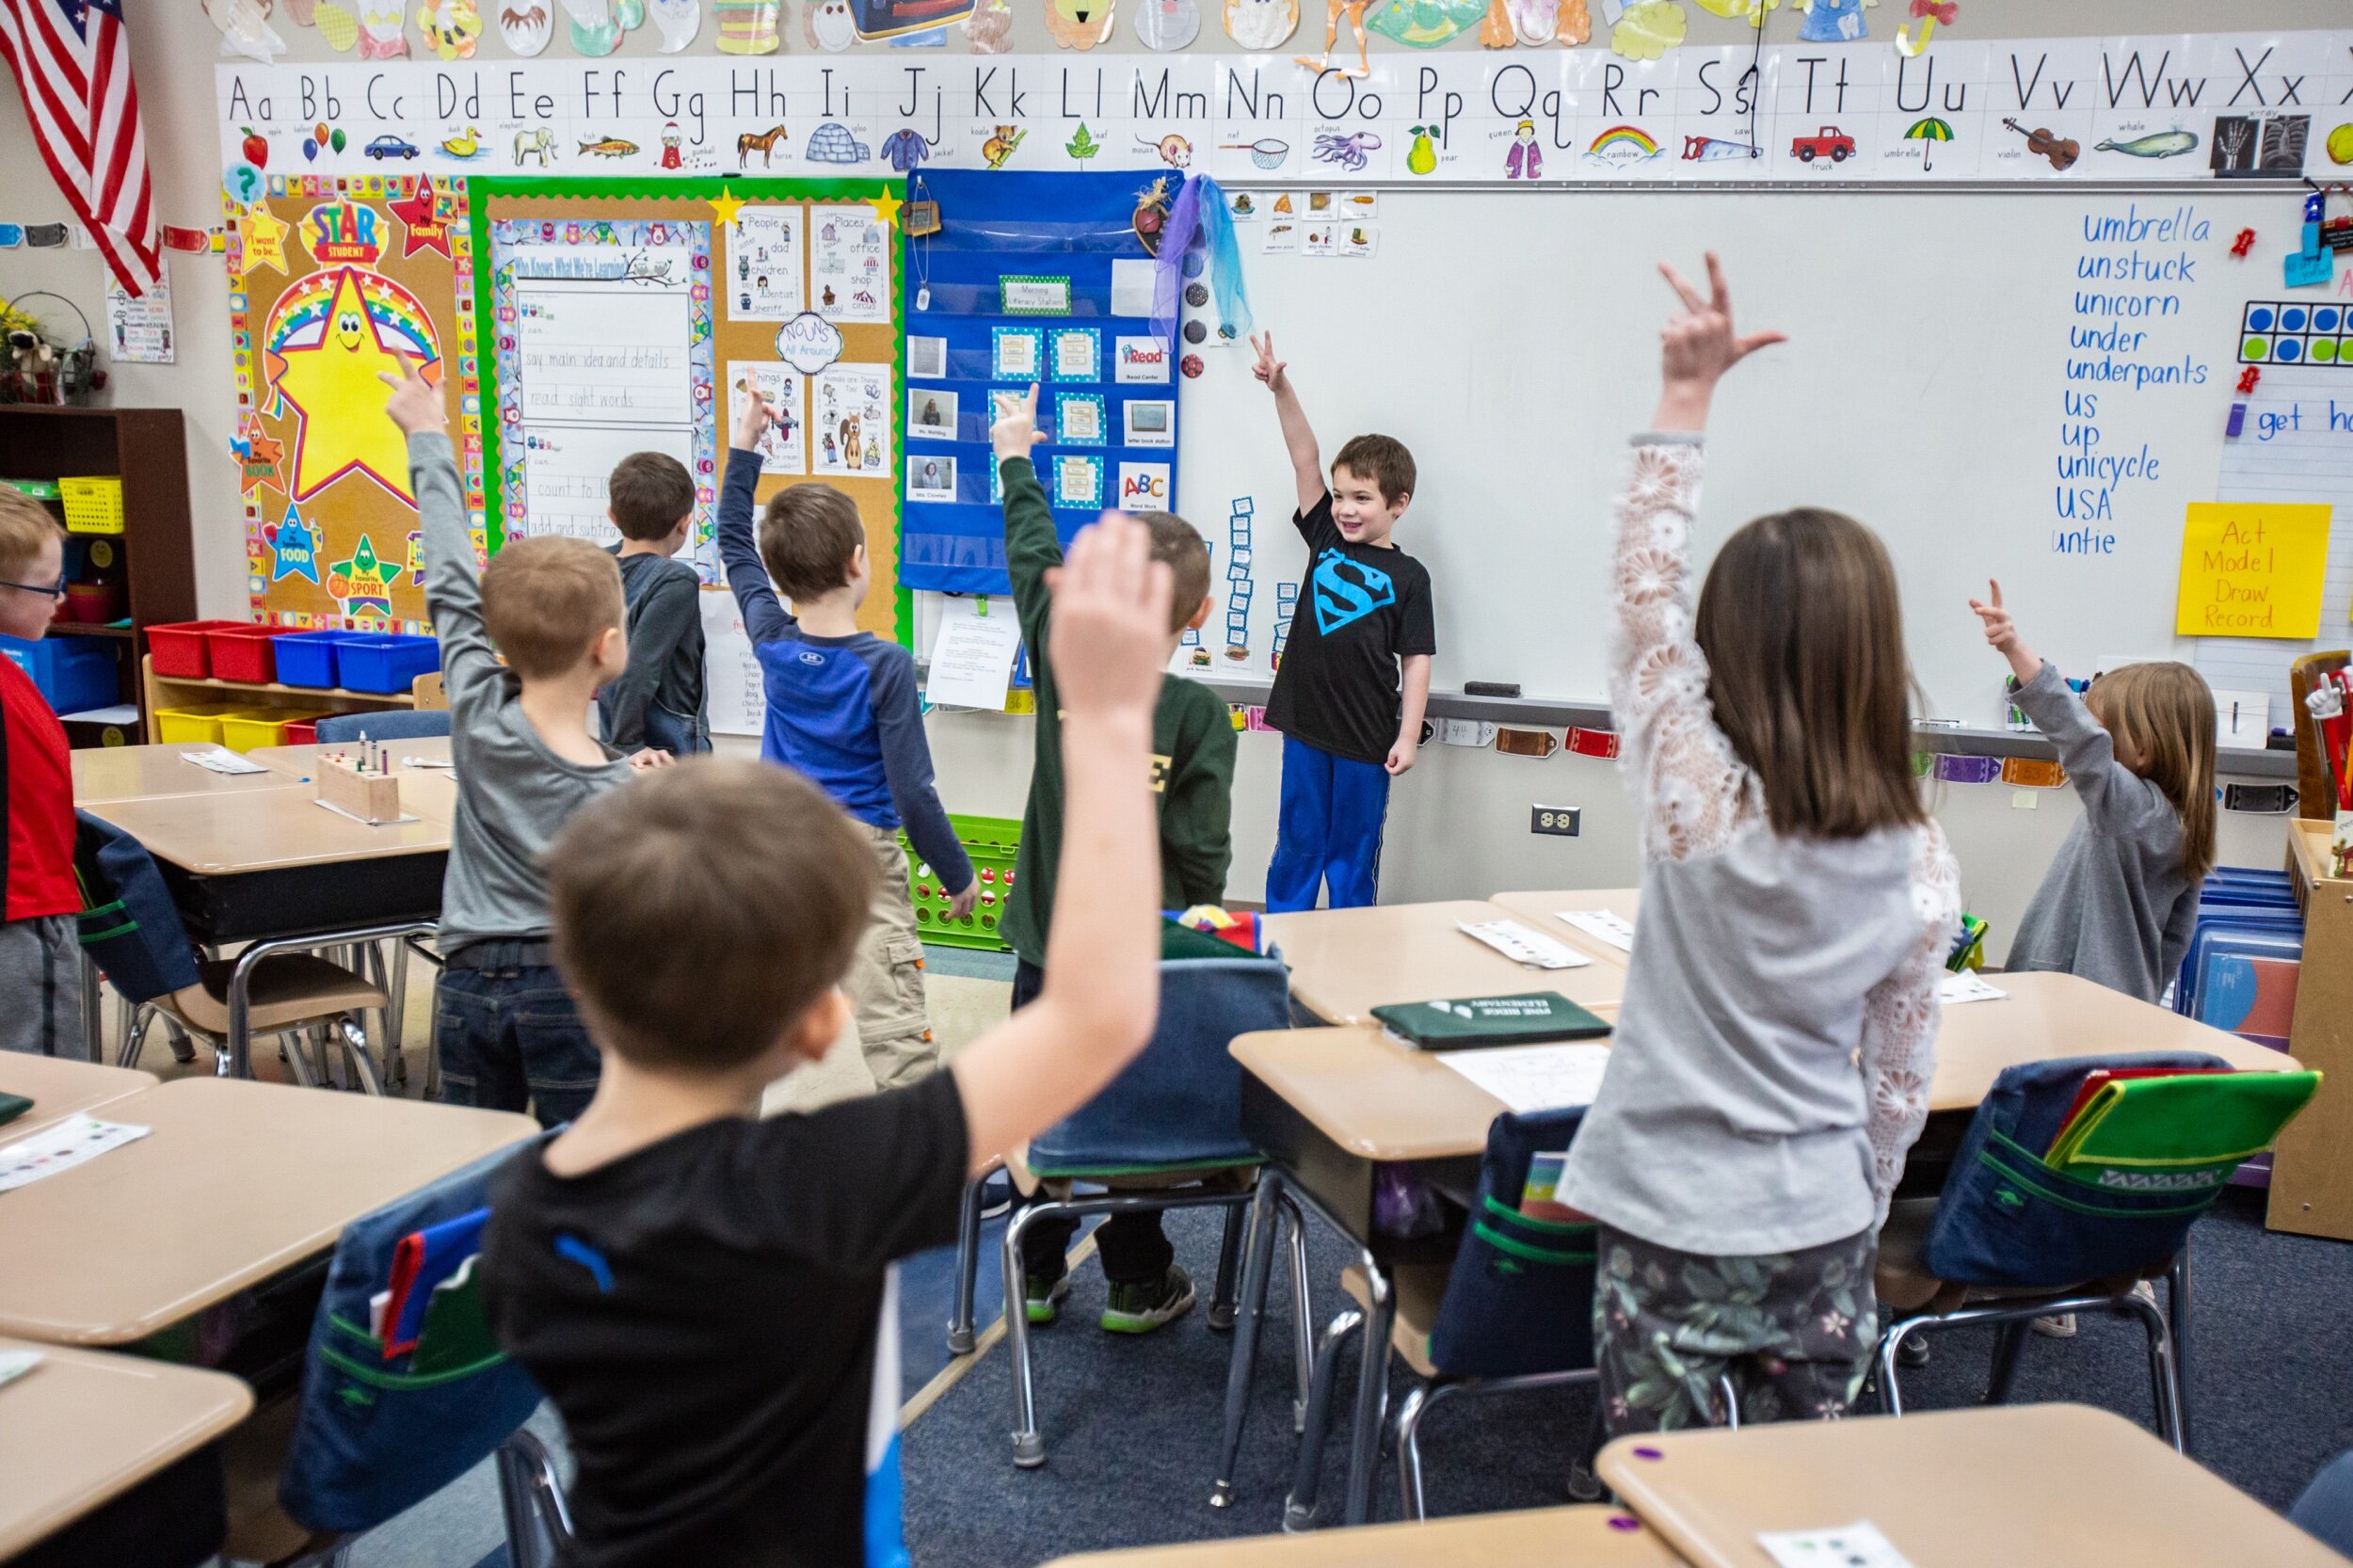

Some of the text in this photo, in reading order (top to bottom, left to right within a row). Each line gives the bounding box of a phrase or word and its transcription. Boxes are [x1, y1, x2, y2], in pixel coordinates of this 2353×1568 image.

[229, 75, 272, 120] Aa
[301, 74, 341, 120] Bb
[367, 74, 405, 120] Cc
[438, 72, 480, 120] Dd
[510, 72, 554, 119] Ee
[585, 70, 626, 118] Ff
[654, 70, 704, 146] Gg
[732, 69, 787, 118] Hh
[899, 68, 942, 146] Jj
[975, 67, 1027, 118] Kk
[1133, 67, 1208, 120] Mm
[1229, 67, 1284, 120] Nn
[1418, 67, 1464, 150] Pp
[1492, 64, 1572, 149] Qq
[1603, 64, 1659, 118] Rr
[1797, 57, 1849, 114] Tt
[2011, 54, 2074, 110] Vv
[2103, 50, 2206, 109] Ww
[2229, 47, 2305, 106] Xx
[2249, 109, 2279, 120] x-ray
[448, 125, 460, 134] duck
[499, 121, 523, 131] elephant
[852, 124, 867, 134] igloo
[971, 126, 990, 136] koala
[1314, 124, 1340, 134] octopus
[2119, 121, 2145, 132] whale
[584, 131, 596, 139] fish
[1093, 130, 1108, 139] leaf
[1227, 130, 1240, 138] net
[1489, 128, 1513, 139] queen
[691, 146, 716, 158] gumball
[934, 148, 954, 158] jacket
[1440, 153, 1459, 162] pear
[1607, 150, 1638, 158] rainbow
[1884, 149, 1921, 158] umbrella
[1997, 149, 2021, 158] violin
[1811, 162, 1833, 171] truck
[312, 203, 376, 246] STAR
[748, 216, 779, 232] People
[835, 216, 865, 228] Places
[2084, 203, 2210, 242] umbrella
[410, 224, 443, 238] Family
[256, 236, 275, 246] want
[253, 247, 262, 256] to
[328, 247, 364, 257] STUDENT
[771, 242, 789, 253] dad
[850, 243, 881, 254] office
[531, 256, 553, 277] Knows
[554, 256, 572, 277] What
[573, 256, 593, 278] We're
[751, 264, 789, 276] children
[2078, 249, 2195, 282] unstuck
[851, 275, 872, 287] shop
[766, 290, 793, 299] dentist
[1021, 285, 1048, 296] Morning
[852, 301, 876, 310] circus
[1008, 296, 1064, 307] Literacy Stations
[2075, 291, 2180, 317] unicorn
[786, 319, 829, 343] NOUNS
[2071, 321, 2147, 353] under
[786, 344, 832, 356] All Around
[526, 345, 669, 373] say main idea and details
[1129, 349, 1162, 364] Read
[2067, 354, 2207, 391] underpants
[756, 373, 781, 385] hings
[531, 384, 633, 415] read sight words
[781, 394, 796, 408] doll
[2065, 390, 2098, 418] us
[2259, 403, 2303, 440] get
[2063, 424, 2100, 456] up
[246, 465, 275, 477] BOOK
[2057, 443, 2159, 492] unicycle
[537, 475, 592, 498] count to
[1125, 473, 1163, 497] ABC
[2057, 486, 2112, 520] USA
[531, 515, 551, 534] add
[557, 515, 574, 536] and
[2221, 519, 2266, 544] Act
[282, 540, 306, 550] Favorite
[2053, 527, 2116, 554] untie
[280, 549, 310, 563] FOOD
[2203, 547, 2274, 573] Model
[350, 582, 384, 596] SPORT
[2216, 579, 2269, 602] Draw
[2204, 604, 2273, 629] Record
[744, 692, 758, 701] dog
